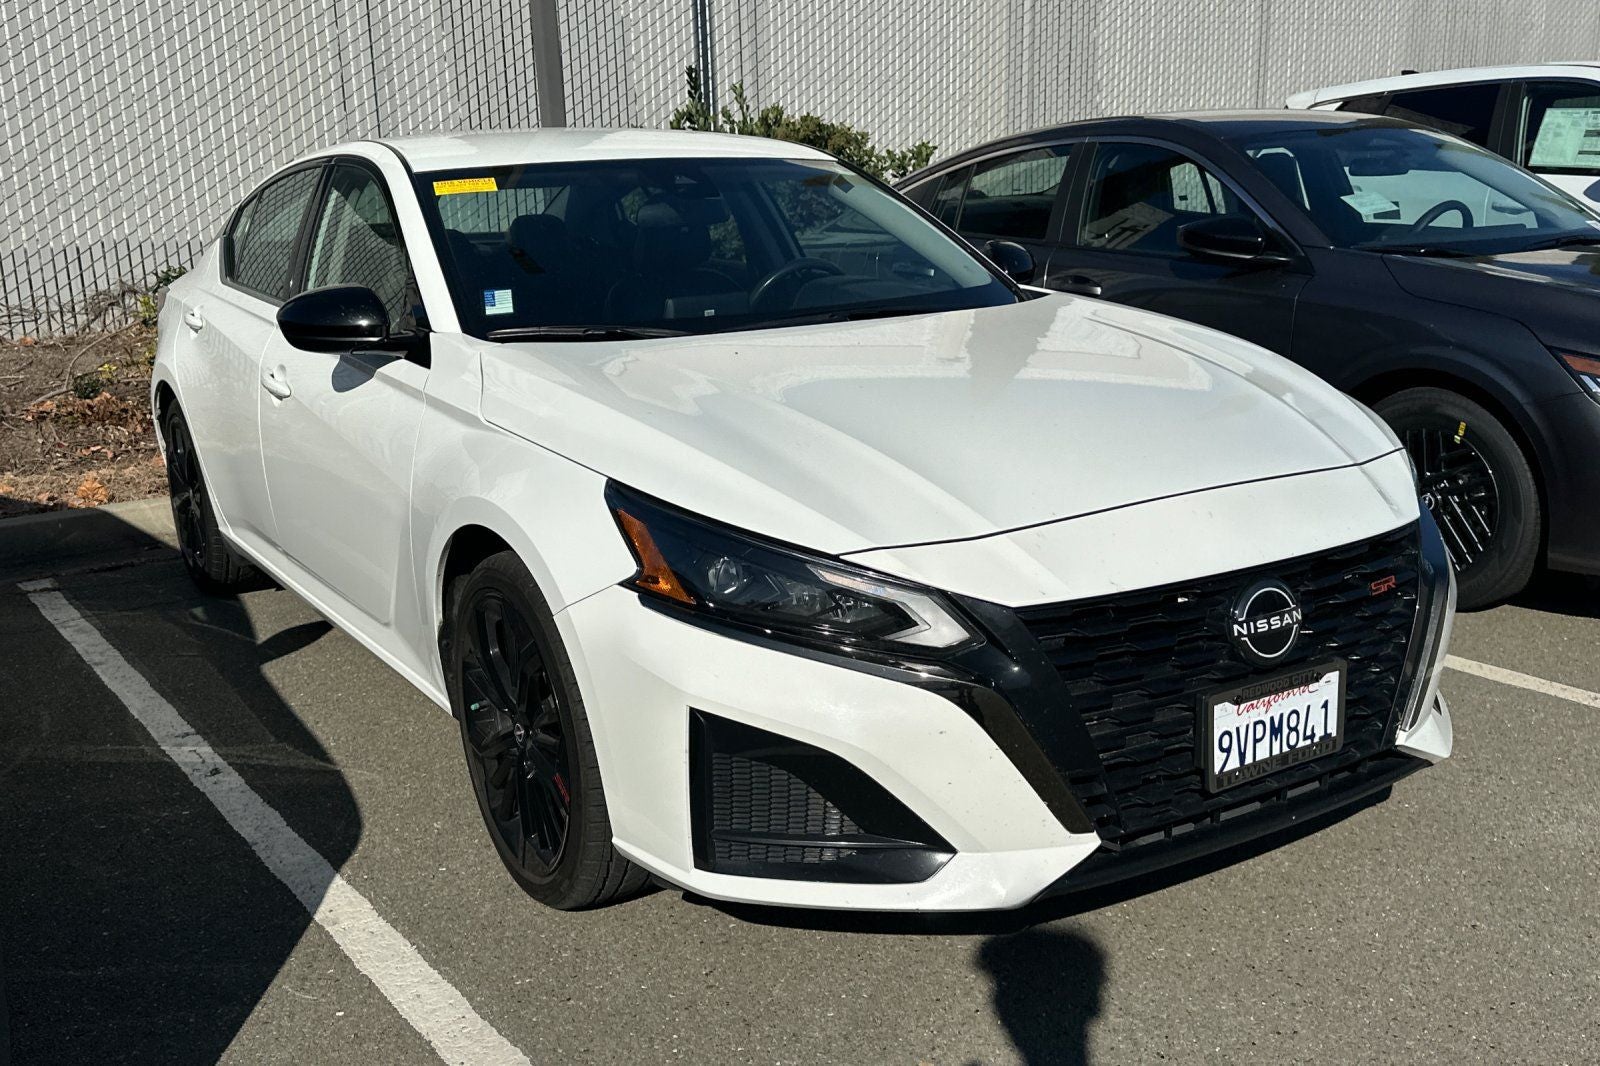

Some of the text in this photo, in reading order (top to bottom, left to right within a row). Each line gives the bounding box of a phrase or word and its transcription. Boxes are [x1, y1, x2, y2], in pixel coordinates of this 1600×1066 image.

[1370, 575, 1396, 596] SR
[1232, 608, 1302, 637] NISSAN
[1236, 683, 1318, 716] California
[1242, 677, 1290, 699] REDWOOD
[1218, 699, 1332, 774] 9VPM841
